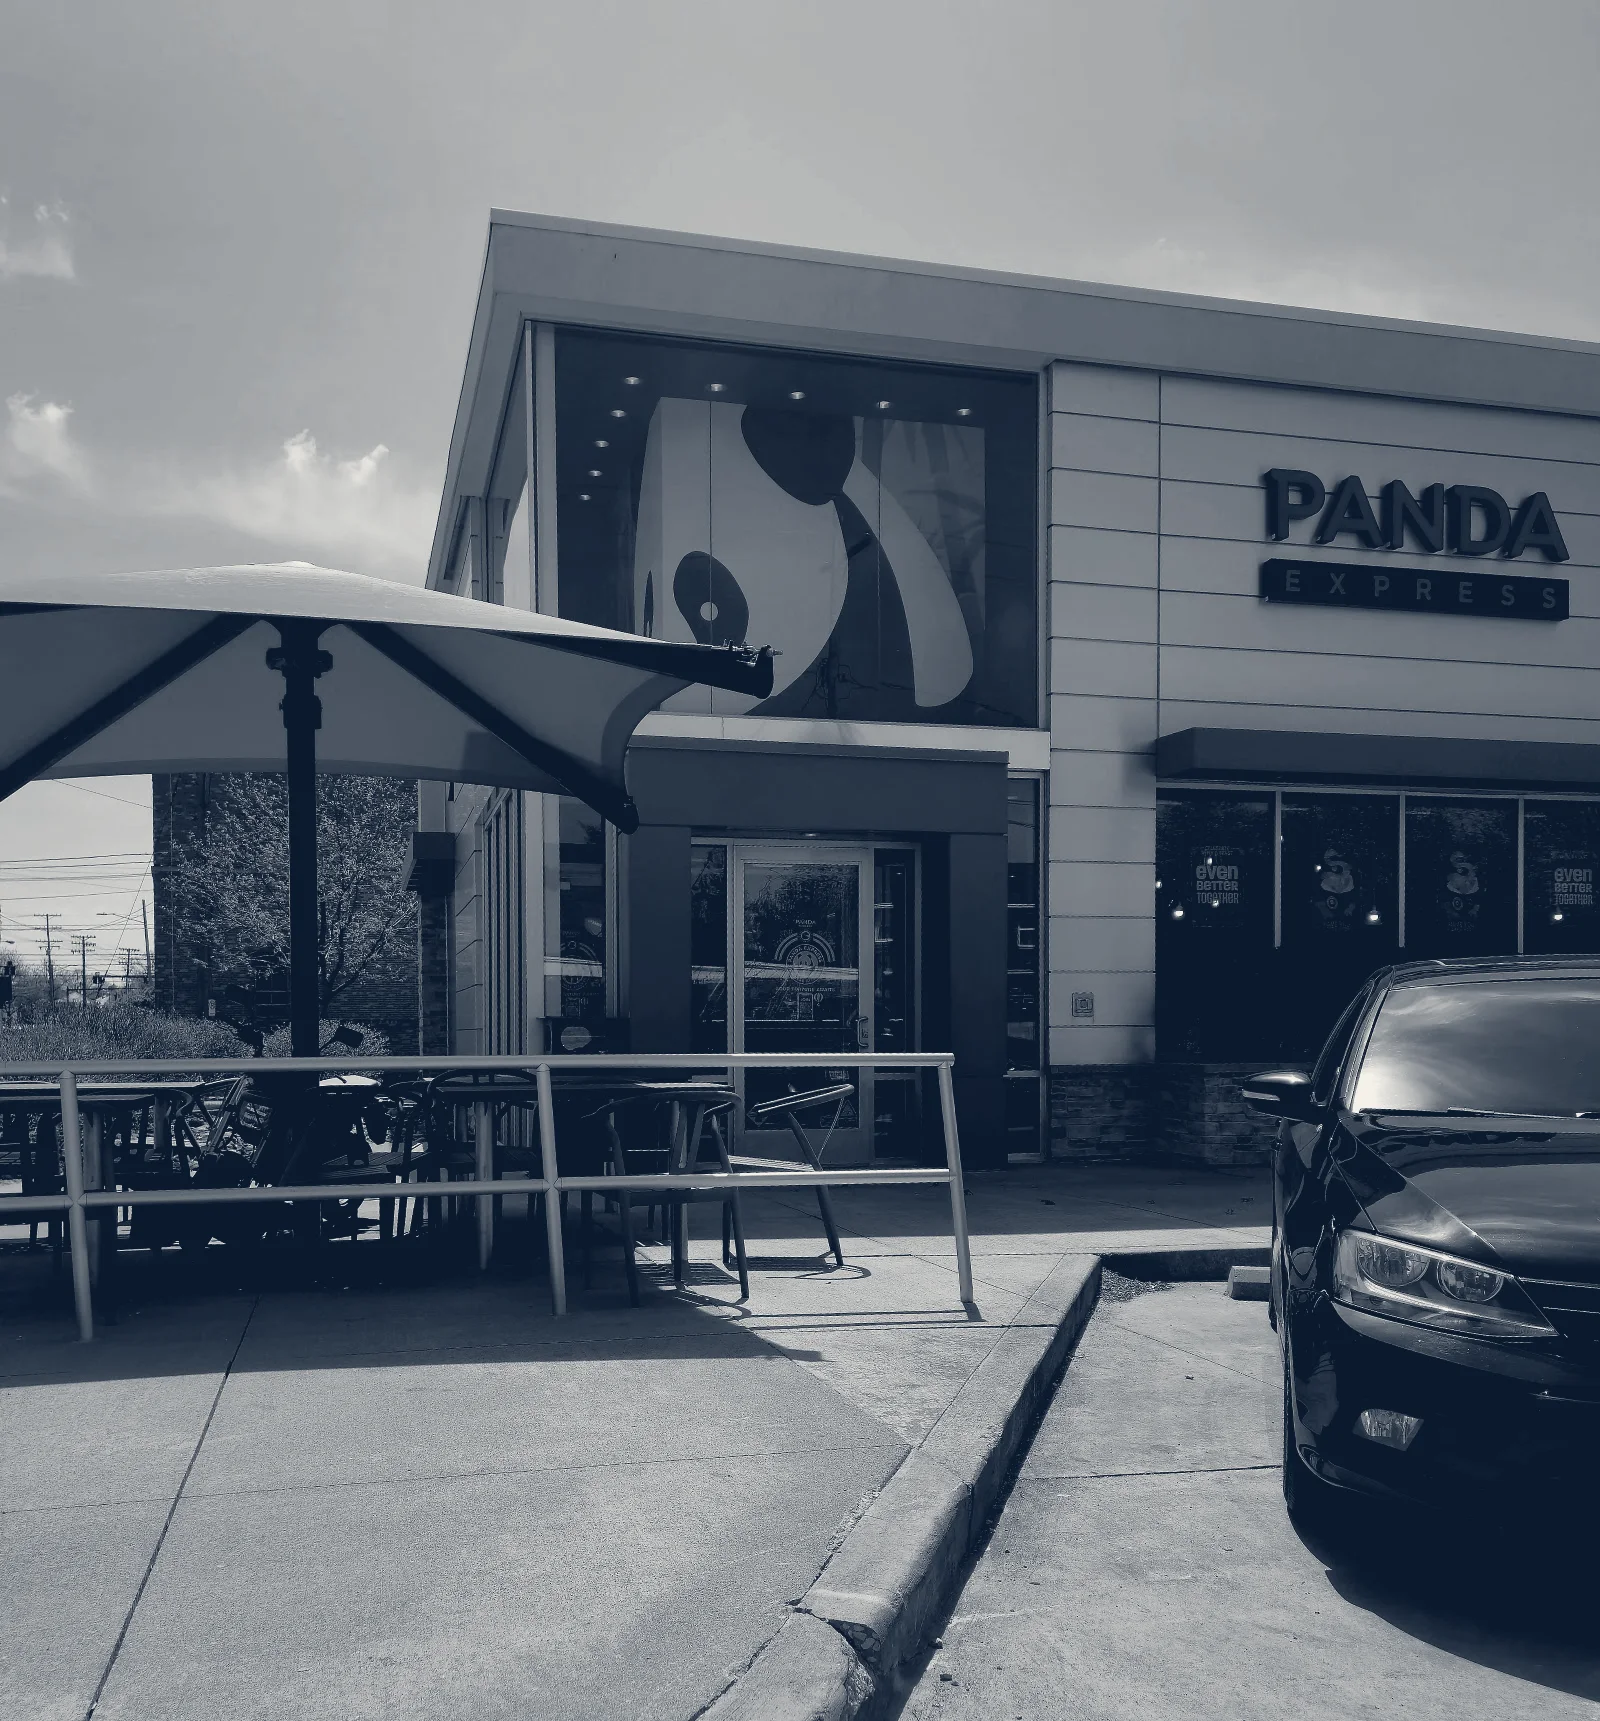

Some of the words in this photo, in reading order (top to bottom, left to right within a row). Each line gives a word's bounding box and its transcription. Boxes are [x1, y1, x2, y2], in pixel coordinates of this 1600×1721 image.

[1262, 468, 1570, 562] PANDA
[1285, 569, 1556, 609] EXPRESS
[1196, 865, 1239, 880] even
[1554, 868, 1593, 882] even
